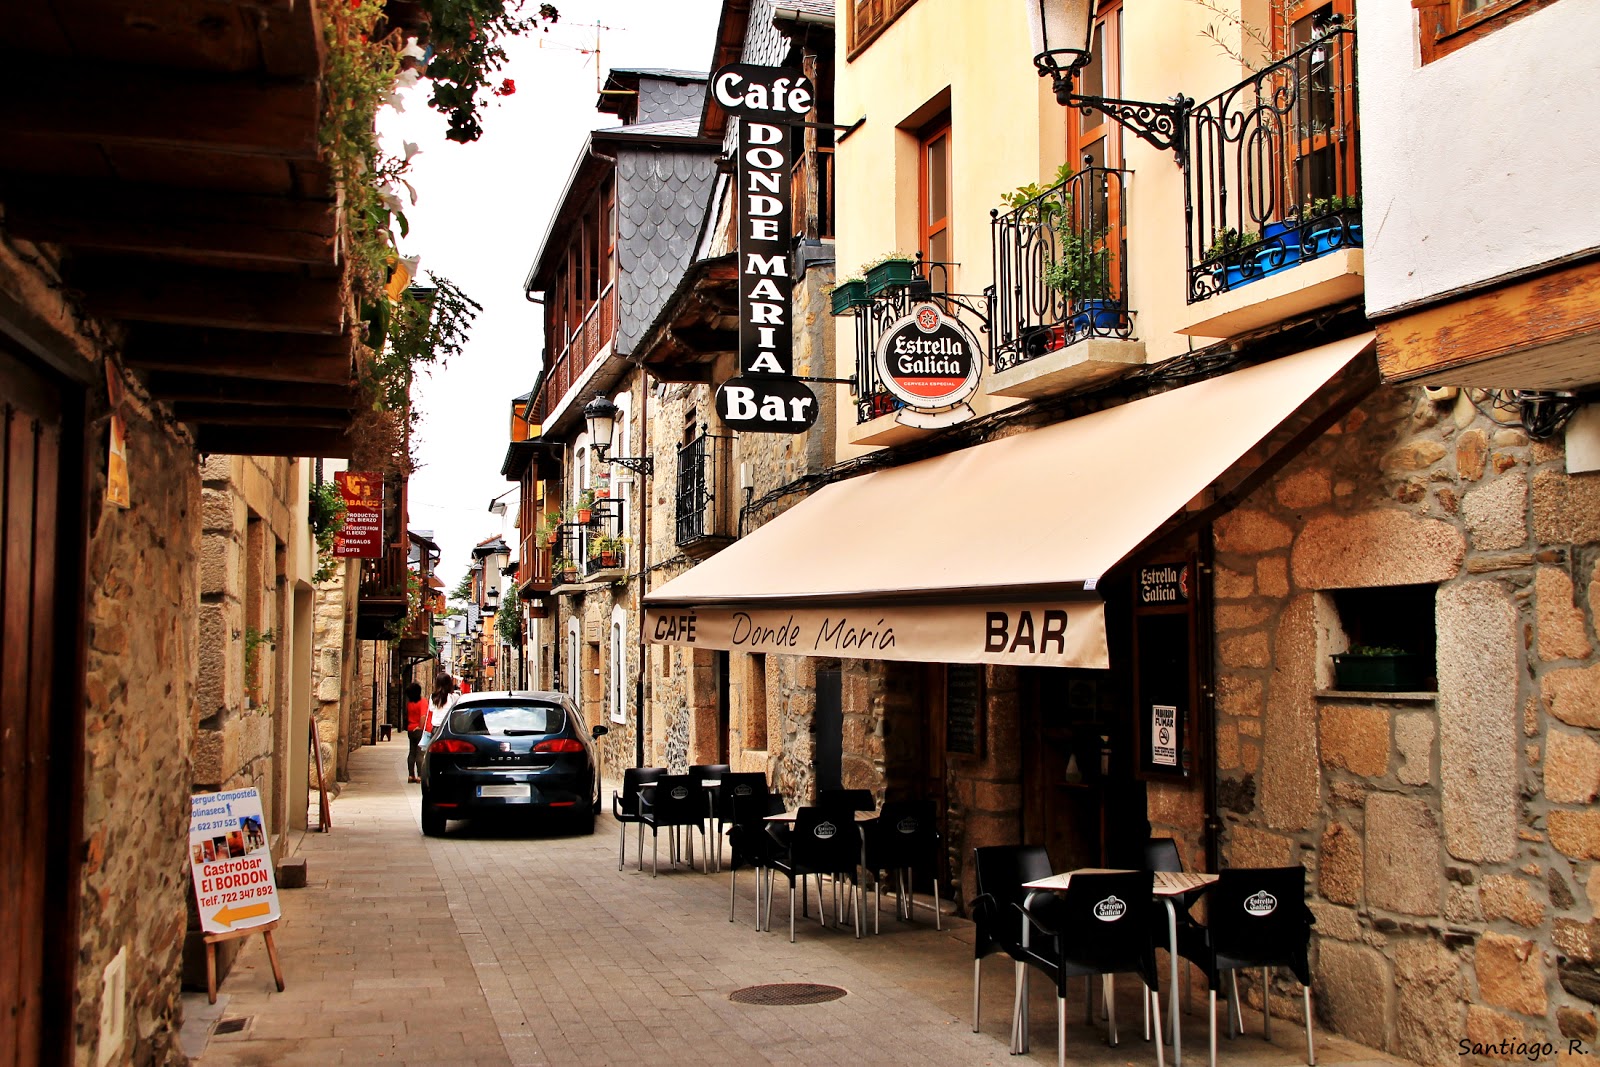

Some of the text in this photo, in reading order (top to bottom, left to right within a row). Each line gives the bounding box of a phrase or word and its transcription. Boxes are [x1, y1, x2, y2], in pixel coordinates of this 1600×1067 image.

[715, 72, 812, 114] Café
[745, 122, 788, 374] DONDE MARIA
[893, 335, 963, 356] Estrella
[897, 354, 961, 375] Galicia
[723, 385, 812, 422] Bar
[1141, 567, 1177, 584] Estrella
[1142, 583, 1176, 602] Galicia
[654, 609, 1068, 655] CAFÉ Donde María BAR
[1155, 717, 1174, 727] FUMAR
[191, 788, 257, 806] bergue Compostela
[192, 806, 226, 818] olinaseca
[197, 820, 211, 831] 622
[212, 819, 223, 829] 317
[224, 818, 237, 828] 525
[203, 857, 262, 878] Gastrobar
[215, 868, 268, 890] BORDON
[200, 885, 273, 908] Telf. 722 347 892
[1099, 903, 1123, 911] Estrella
